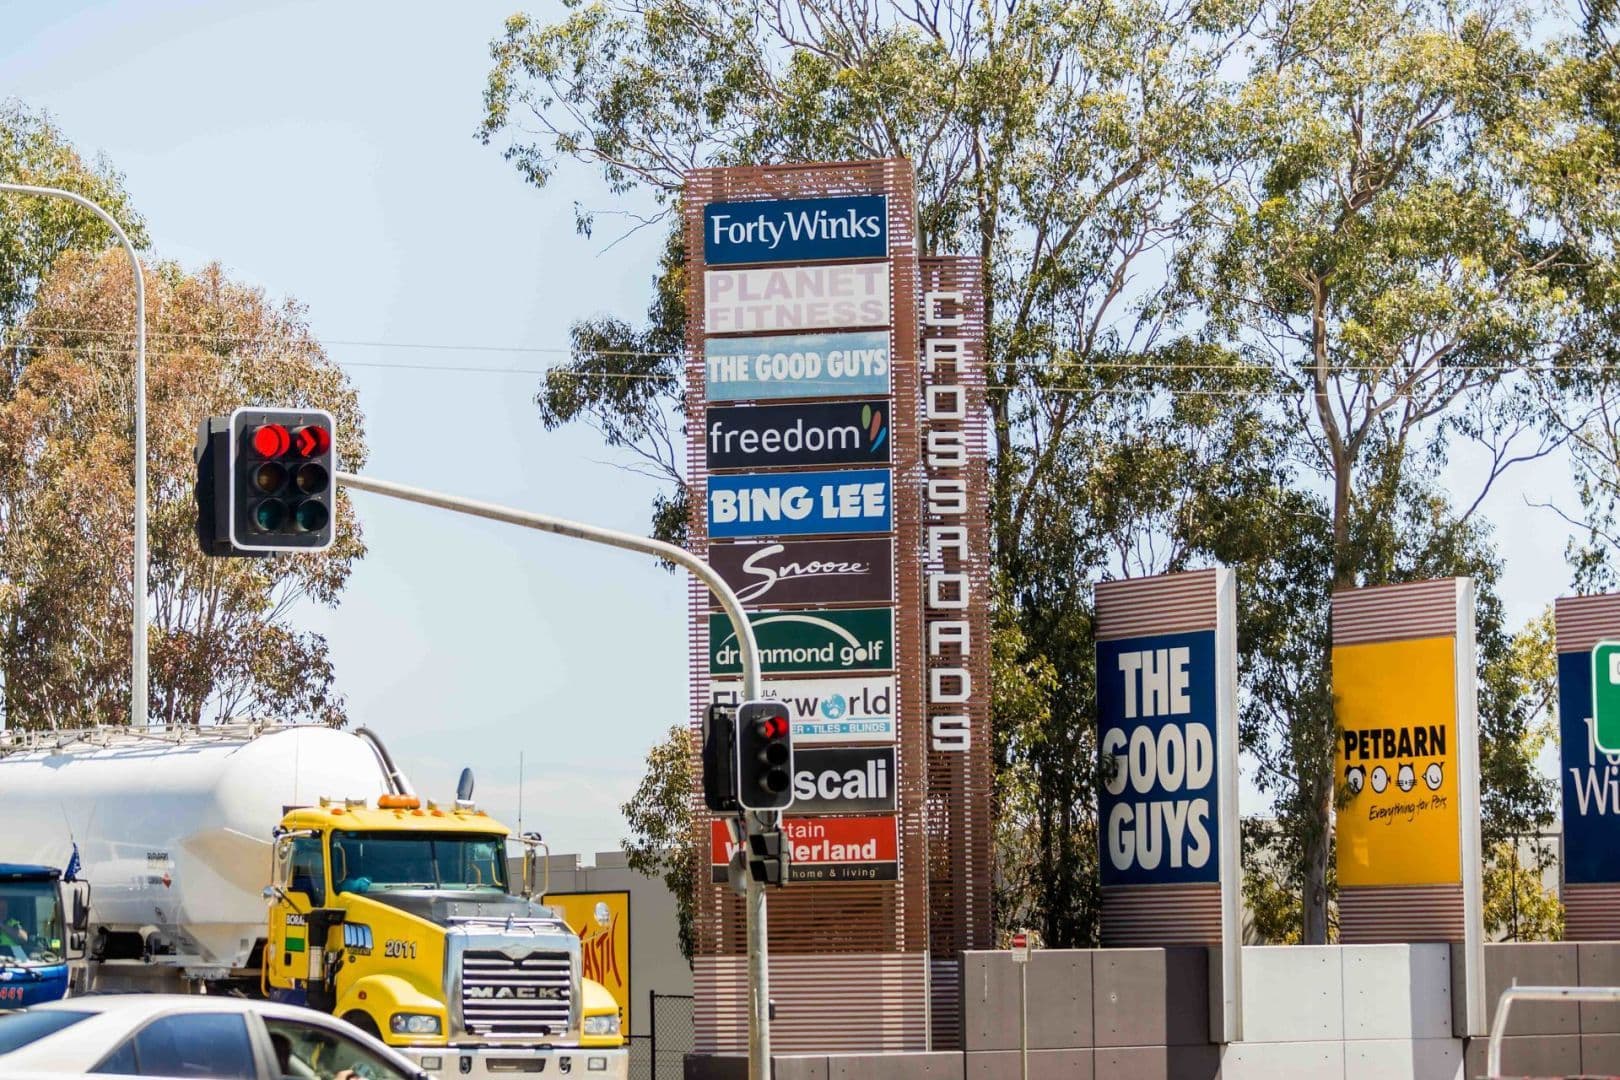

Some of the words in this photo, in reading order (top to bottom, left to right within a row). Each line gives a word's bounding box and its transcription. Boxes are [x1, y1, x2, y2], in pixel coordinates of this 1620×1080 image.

[709, 266, 883, 303] PLANET
[709, 300, 883, 331] FITNESS
[707, 354, 749, 383] THE
[755, 351, 821, 381] GOOD
[827, 348, 887, 378] GUYS
[709, 418, 860, 453] freedom
[711, 486, 813, 524] BING
[820, 482, 886, 519] LEE
[924, 291, 971, 751] CROSSROADS
[734, 544, 869, 602] Snooze
[715, 642, 833, 665] drmmond
[840, 640, 884, 666] golf
[1118, 646, 1190, 718] THE
[813, 723, 840, 735] TILES
[849, 721, 886, 734] BLINDS
[1343, 725, 1446, 760] PETBARN
[1102, 722, 1213, 796] GOOD
[1108, 798, 1211, 871] GUYS
[792, 869, 823, 878] home
[829, 868, 836, 877] &
[843, 867, 876, 878] living
[385, 939, 417, 959] 2011
[470, 986, 561, 998] MACK
